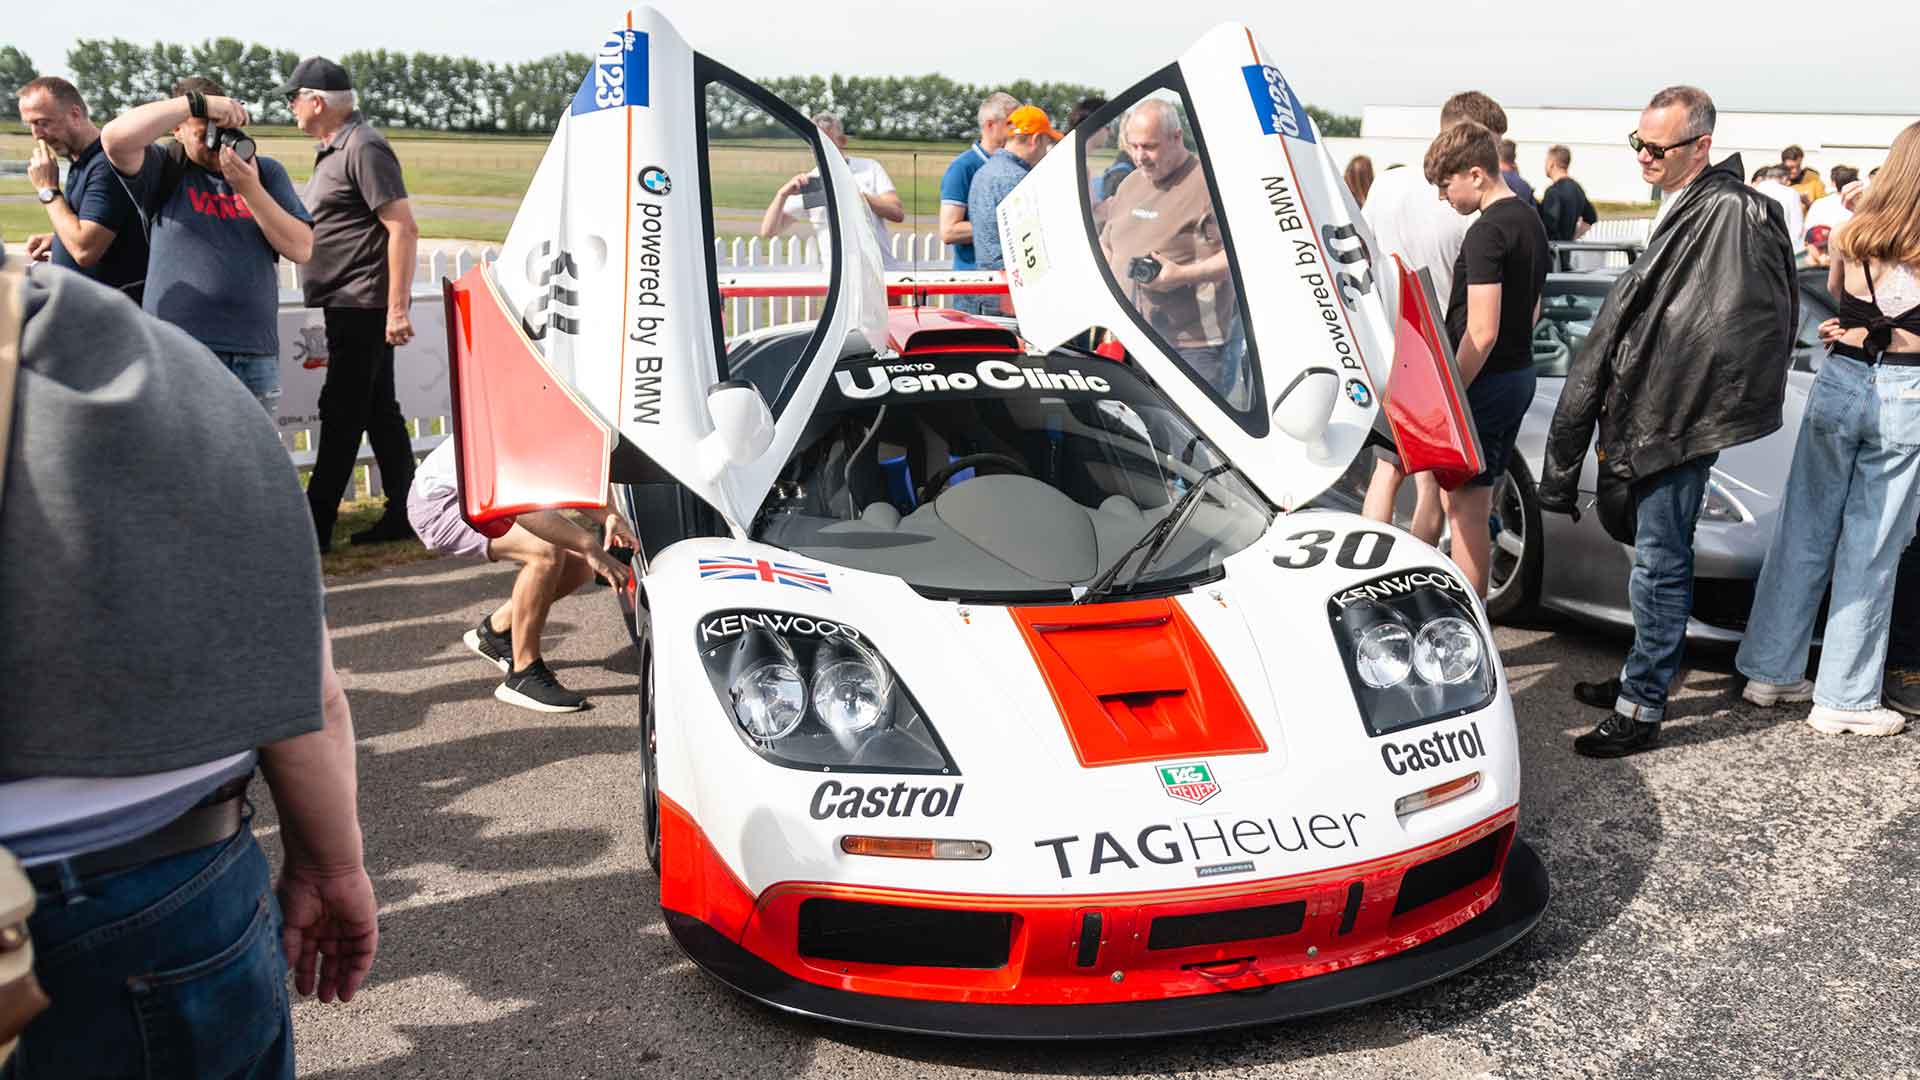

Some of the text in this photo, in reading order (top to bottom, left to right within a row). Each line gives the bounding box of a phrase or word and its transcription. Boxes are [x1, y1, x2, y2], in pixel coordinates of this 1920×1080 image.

[1261, 176, 1303, 232] BMW
[637, 202, 666, 307] powered
[1293, 239, 1317, 266] by
[630, 316, 665, 346] by
[1301, 272, 1361, 371] powered
[885, 362, 935, 374] TOKYO
[633, 356, 663, 425] BMW
[1273, 530, 1396, 569] 30
[1333, 573, 1466, 608] KENWOOD
[701, 614, 859, 641] KENWOOD
[1381, 722, 1486, 776] Castrol
[1168, 767, 1203, 783] TAG
[1171, 783, 1216, 800] HEUER
[810, 780, 964, 820] Castrol
